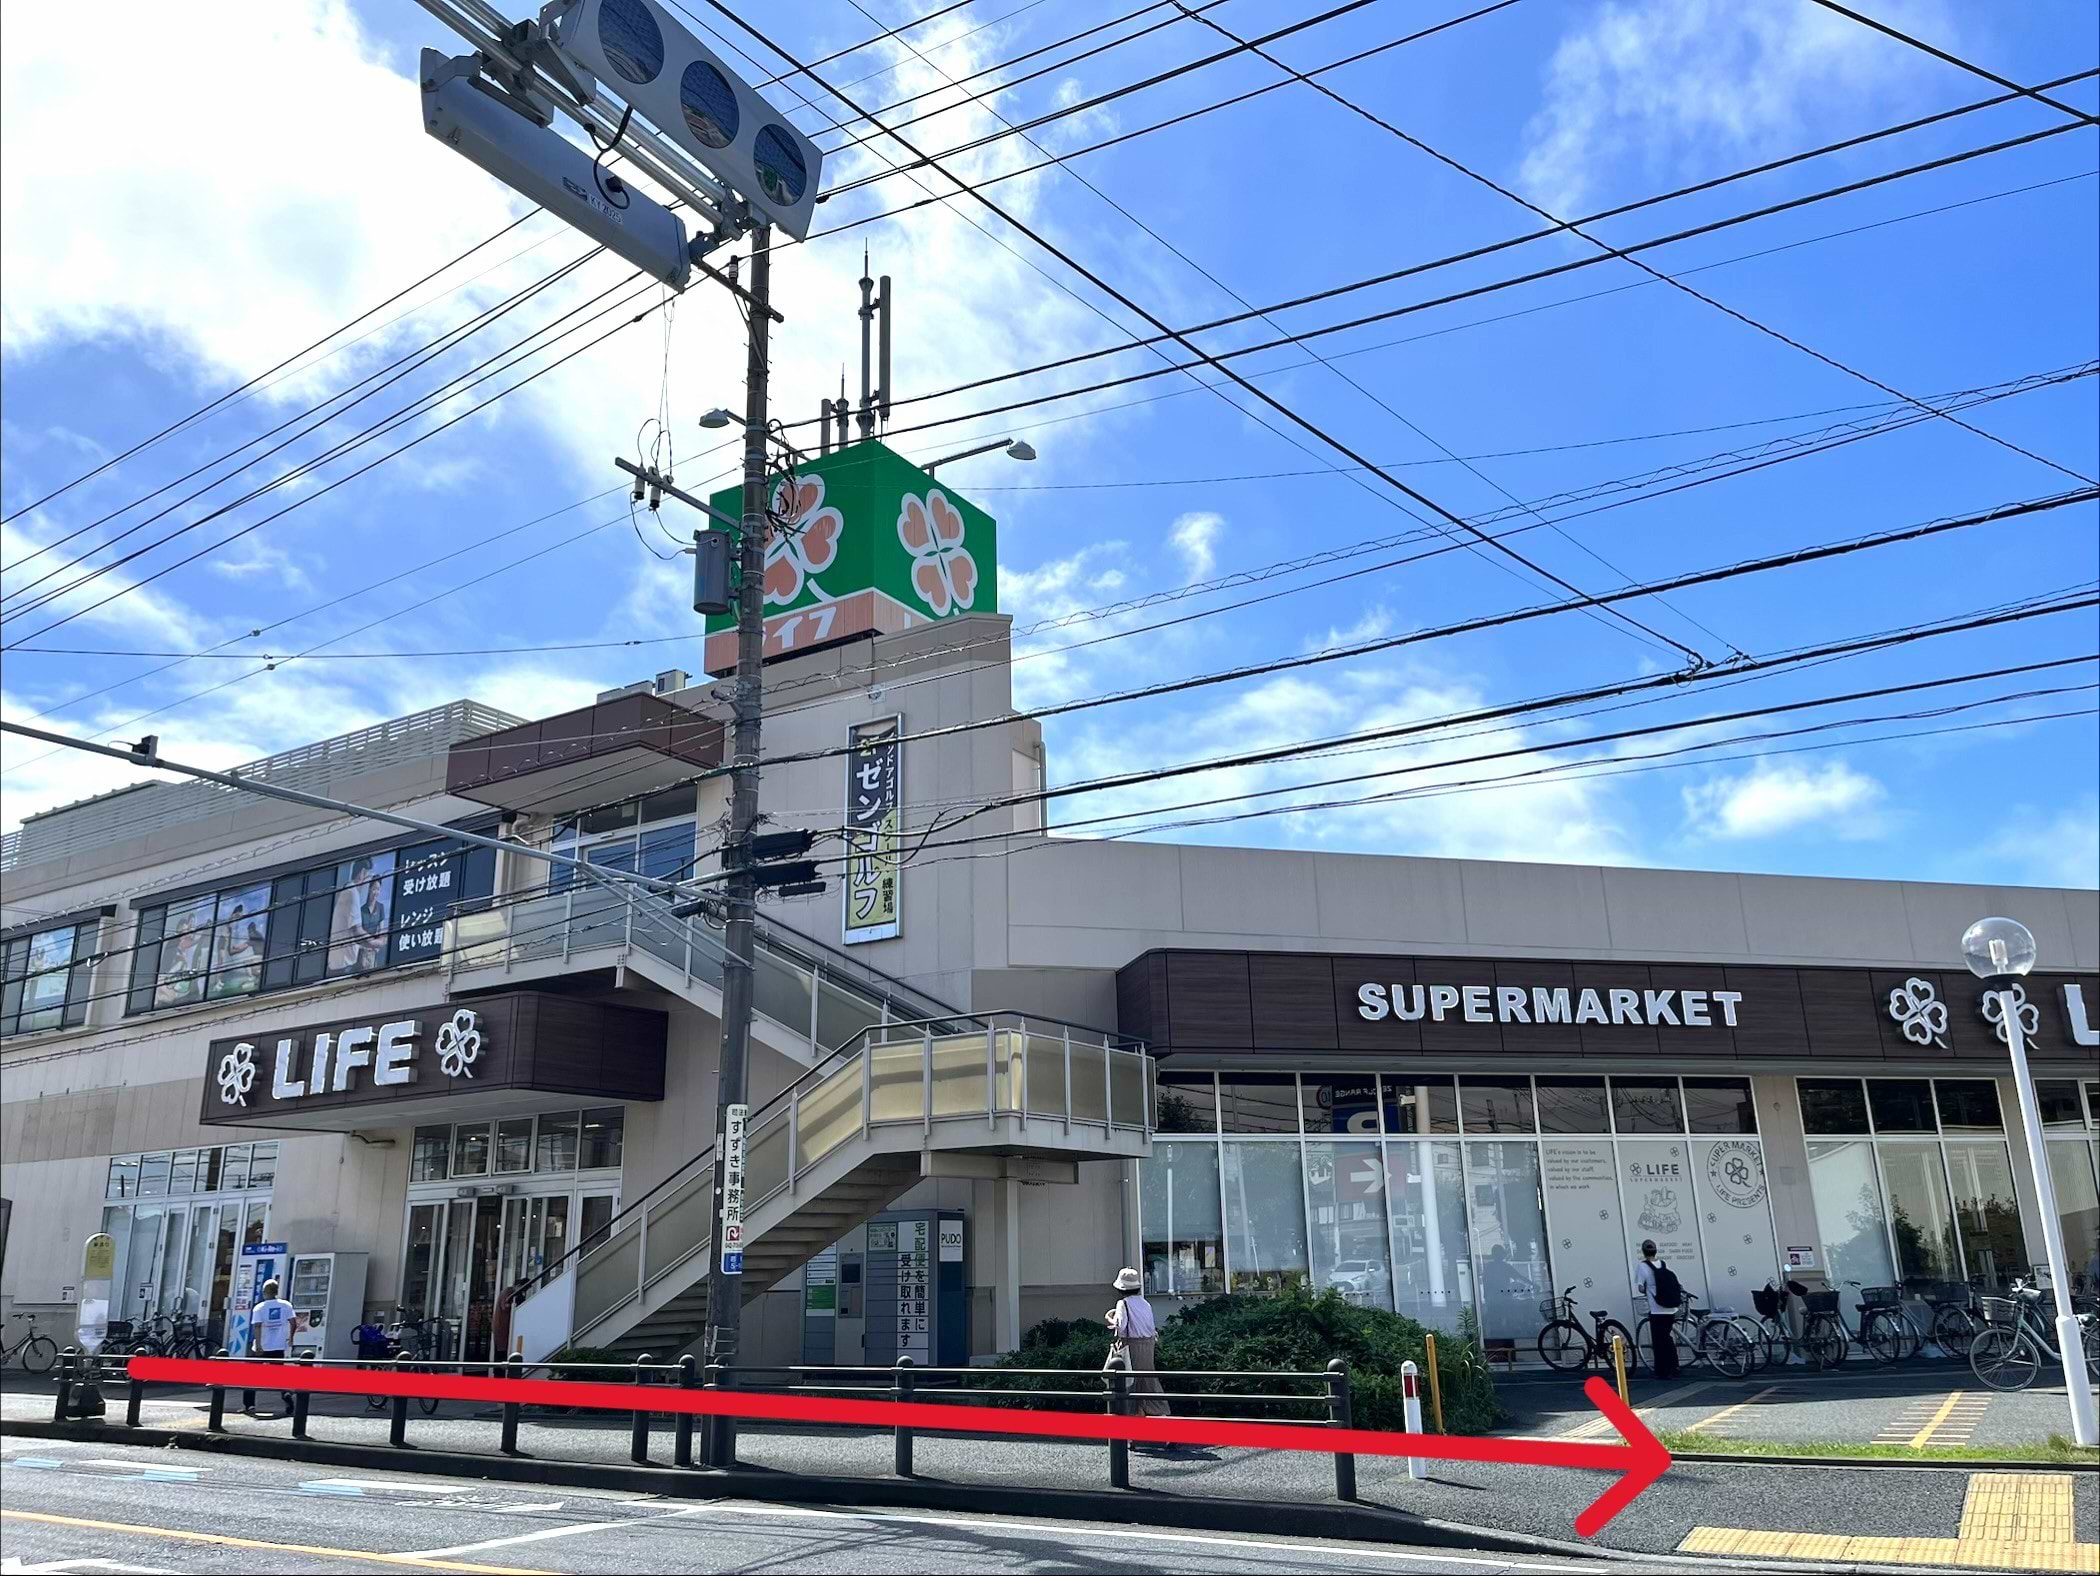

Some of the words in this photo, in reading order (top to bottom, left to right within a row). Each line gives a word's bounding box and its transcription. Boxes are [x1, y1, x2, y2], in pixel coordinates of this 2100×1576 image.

[602, 203, 622, 224] 2025
[762, 606, 837, 649] イフ
[403, 871, 451, 896] 受け放題
[401, 906, 434, 929] レンジ
[1357, 982, 1743, 1027] SUPERMARKET
[271, 1019, 420, 1100] LIFE
[1646, 1164, 1680, 1175] LIFE
[941, 1233, 961, 1244] PUDO
[914, 1222, 927, 1331] 宅配便を簡単に
[900, 1253, 911, 1347] 受け取れます
